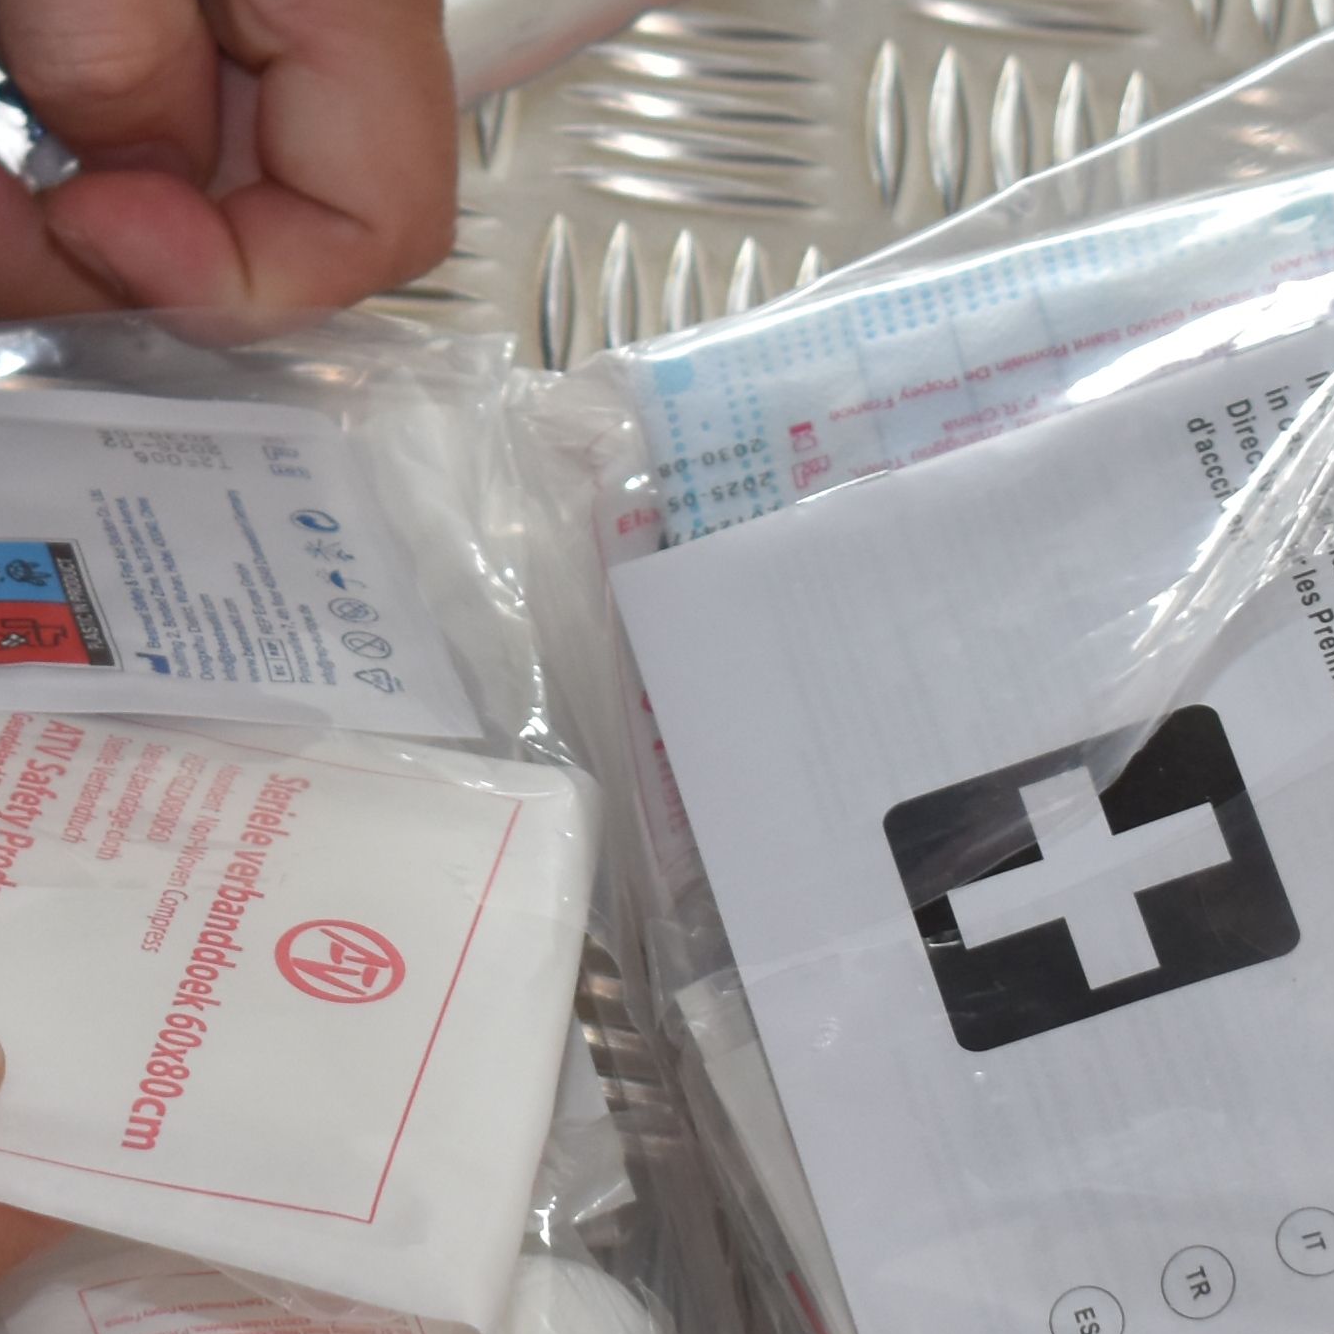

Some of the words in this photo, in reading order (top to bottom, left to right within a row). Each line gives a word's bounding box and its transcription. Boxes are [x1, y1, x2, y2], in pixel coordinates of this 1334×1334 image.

[1266, 385, 1289, 411] in
[53, 556, 89, 602] PRODUCT
[1293, 569, 1320, 606] les
[35, 720, 83, 760] ATV
[64, 767, 113, 843] Verbandtuch
[108, 773, 149, 829] bandage
[242, 775, 309, 846] Steriele
[96, 829, 128, 861] cloth
[170, 818, 218, 887] Non-Woven
[141, 889, 188, 952] Compress
[178, 852, 263, 1007] verbanddoek
[290, 928, 391, 997] ATV
[125, 1014, 205, 1149] 60x80cm
[1301, 1231, 1327, 1250] IT
[1186, 1266, 1211, 1299] TR
